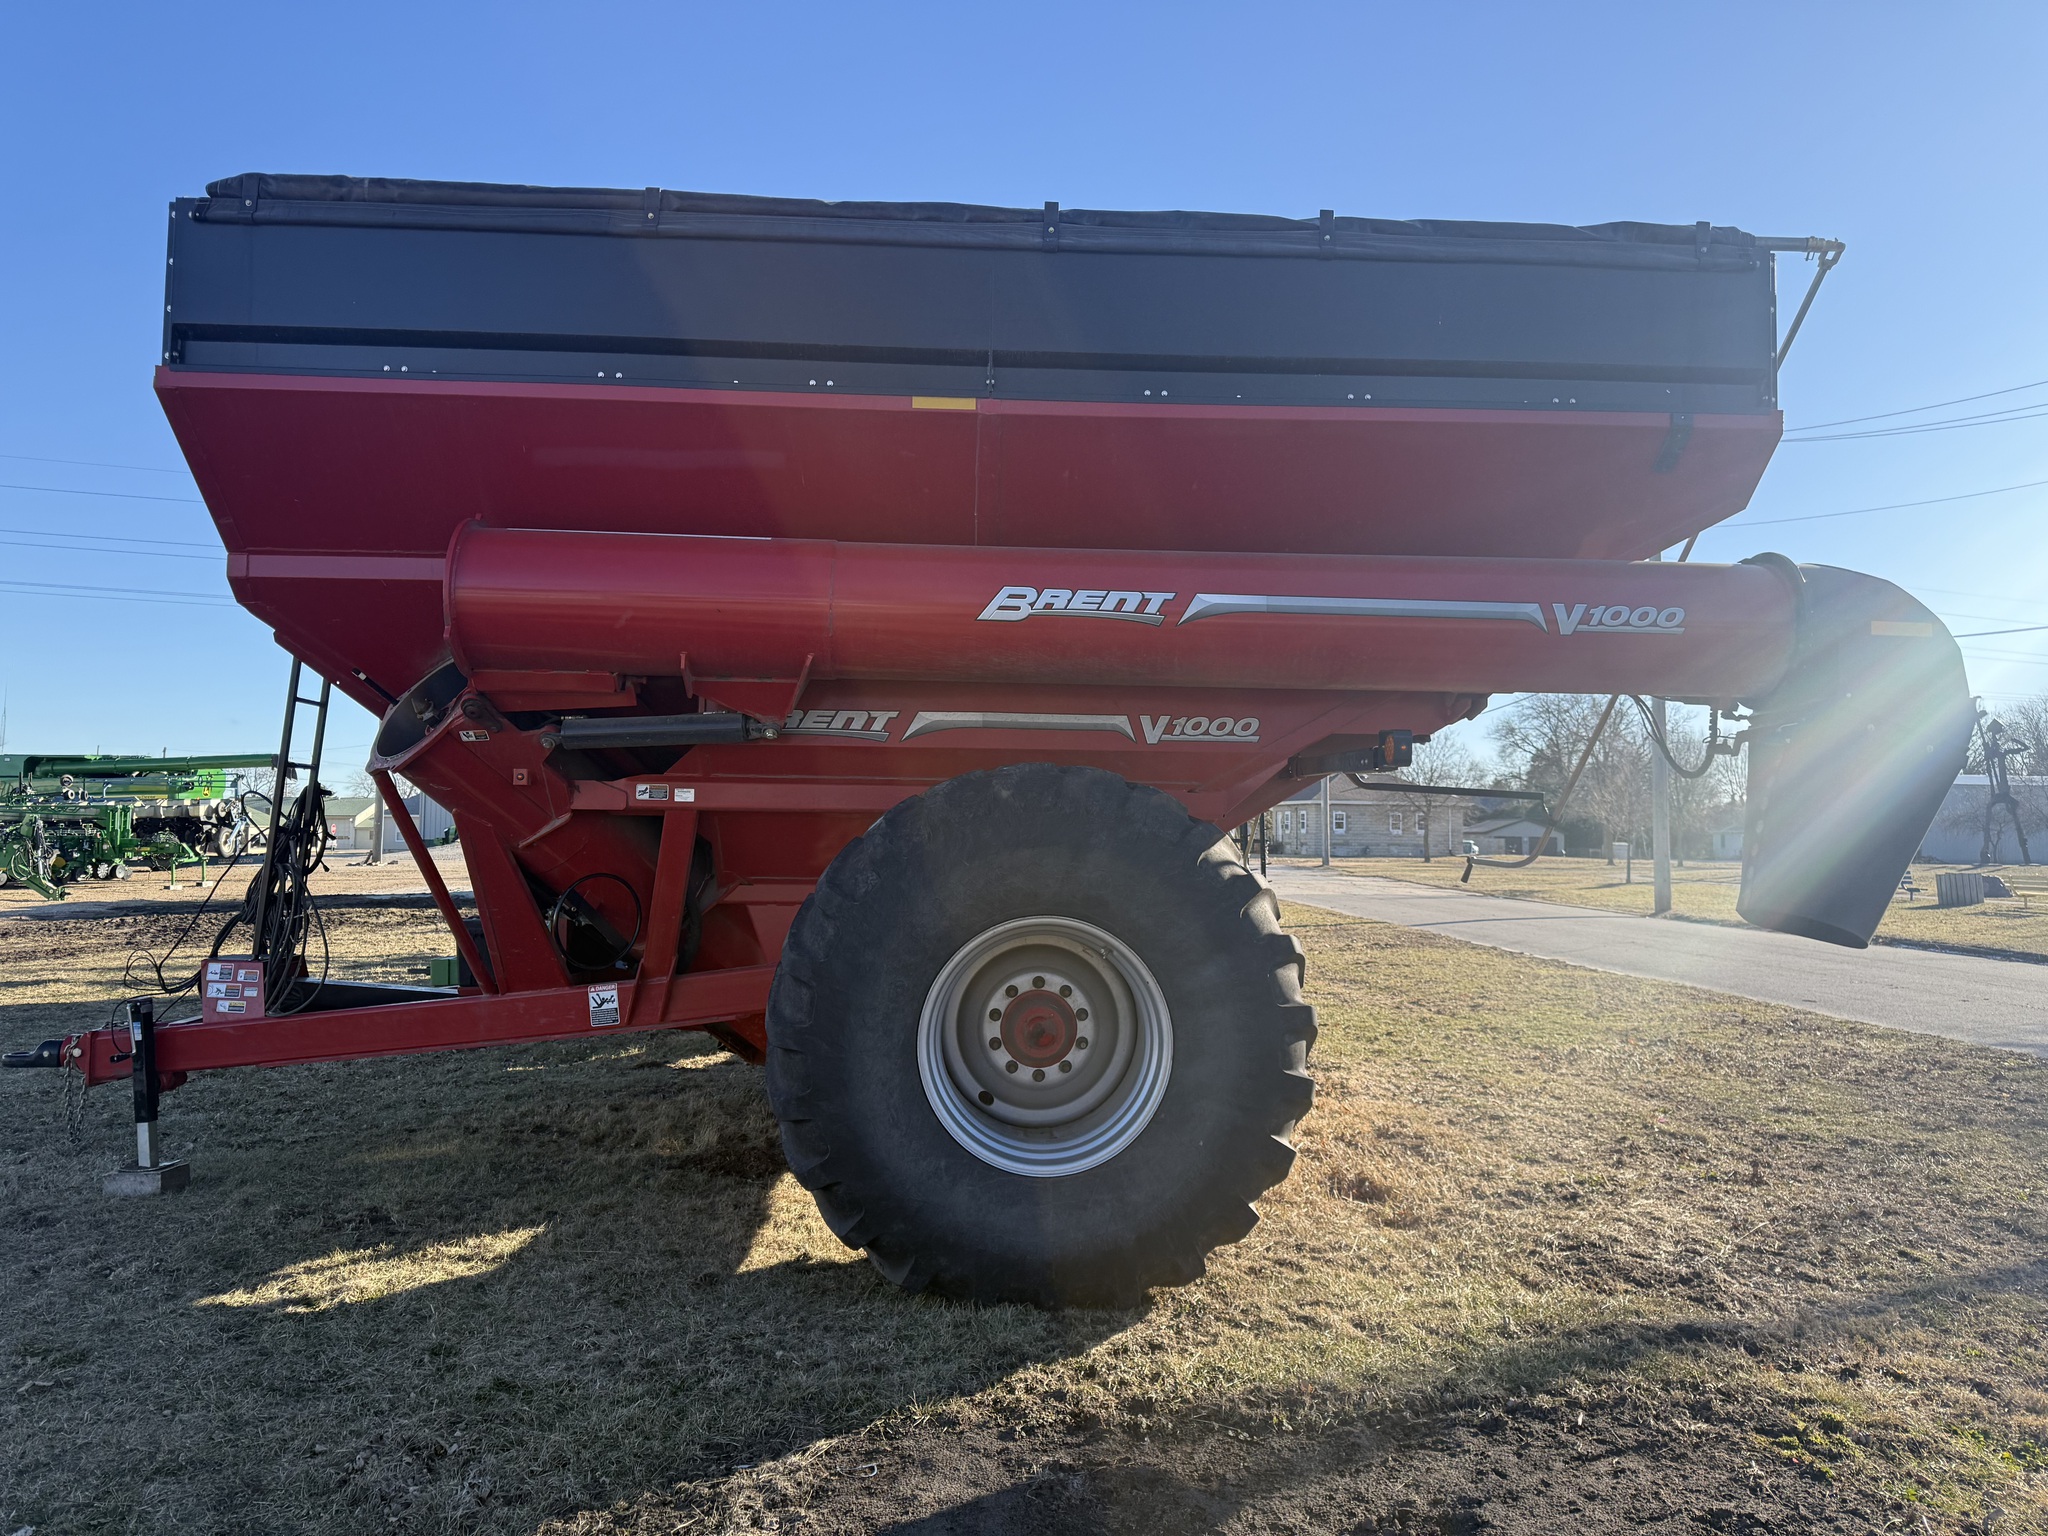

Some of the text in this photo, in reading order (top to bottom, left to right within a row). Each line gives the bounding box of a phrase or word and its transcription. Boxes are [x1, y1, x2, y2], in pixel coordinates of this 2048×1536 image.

[976, 586, 1685, 635] BRENT V1000
[1139, 715, 1260, 744] V1000
